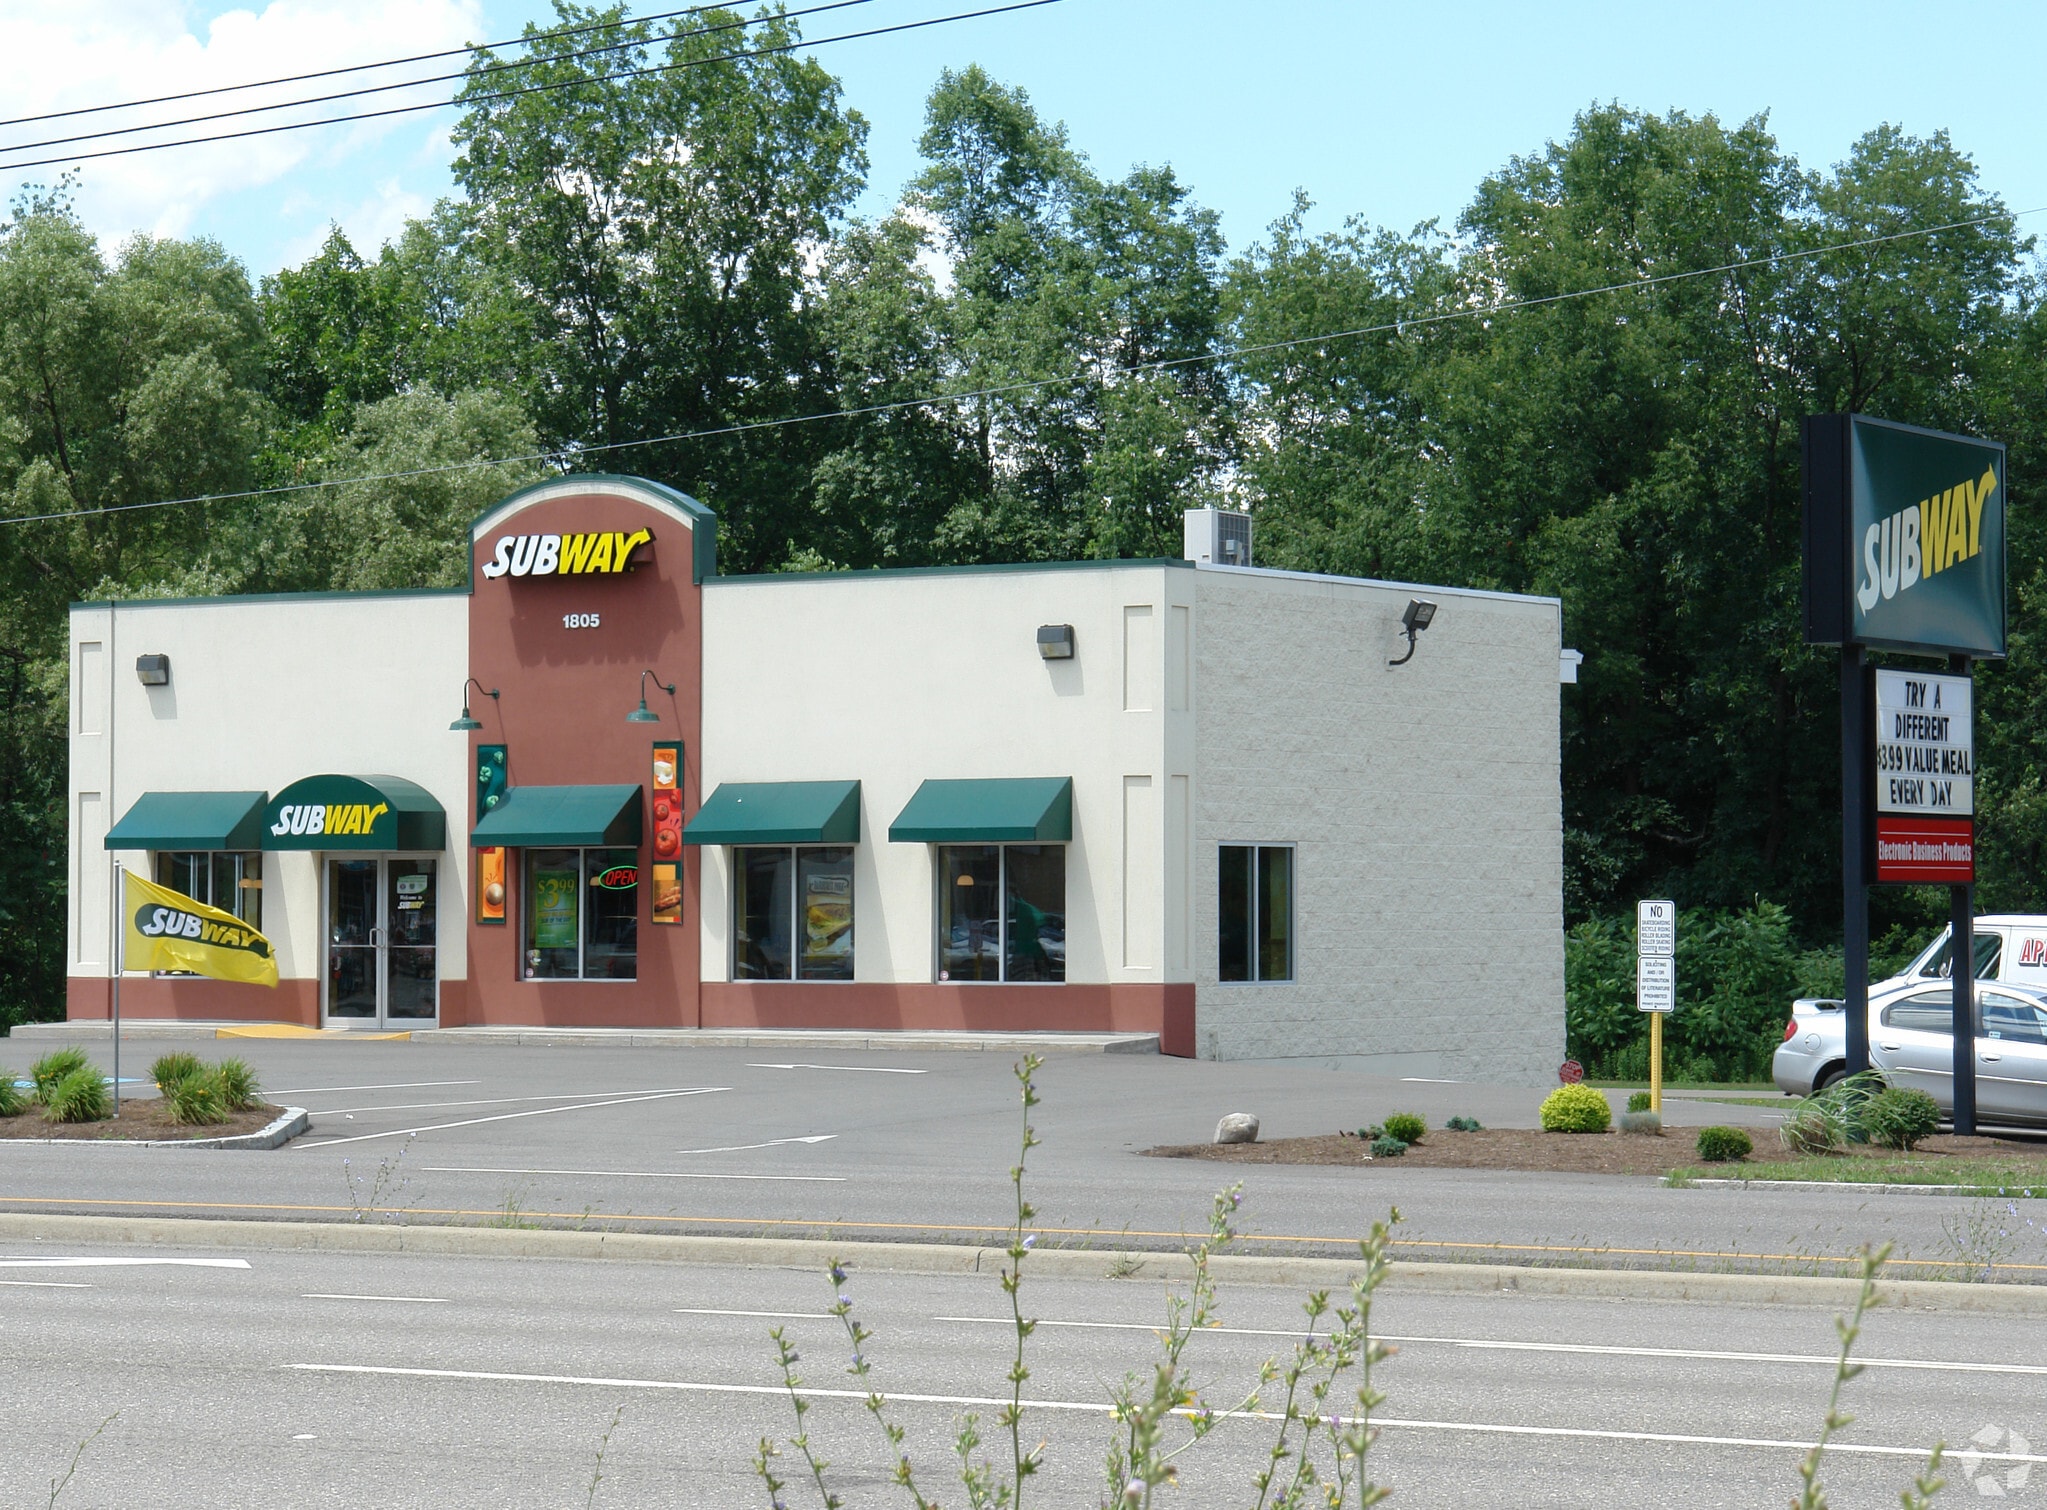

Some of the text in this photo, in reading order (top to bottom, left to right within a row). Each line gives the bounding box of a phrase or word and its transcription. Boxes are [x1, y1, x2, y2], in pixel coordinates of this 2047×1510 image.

[481, 527, 652, 579] SUBWAY
[1857, 462, 1998, 617] SUBWAY
[562, 613, 600, 629] 1805
[1905, 681, 1941, 709] TRY A
[1895, 713, 1950, 742] DIFFERENT
[1905, 746, 1939, 773] VALUE
[1942, 749, 1971, 775] MEAL
[1890, 779, 1952, 806] EVERY DAY
[270, 801, 389, 837] SUBWAY
[1879, 840, 1971, 861] Electronic Business Products
[605, 869, 637, 886] OPEN
[1650, 905, 1663, 918] NO
[142, 908, 265, 947] SUBWAY
